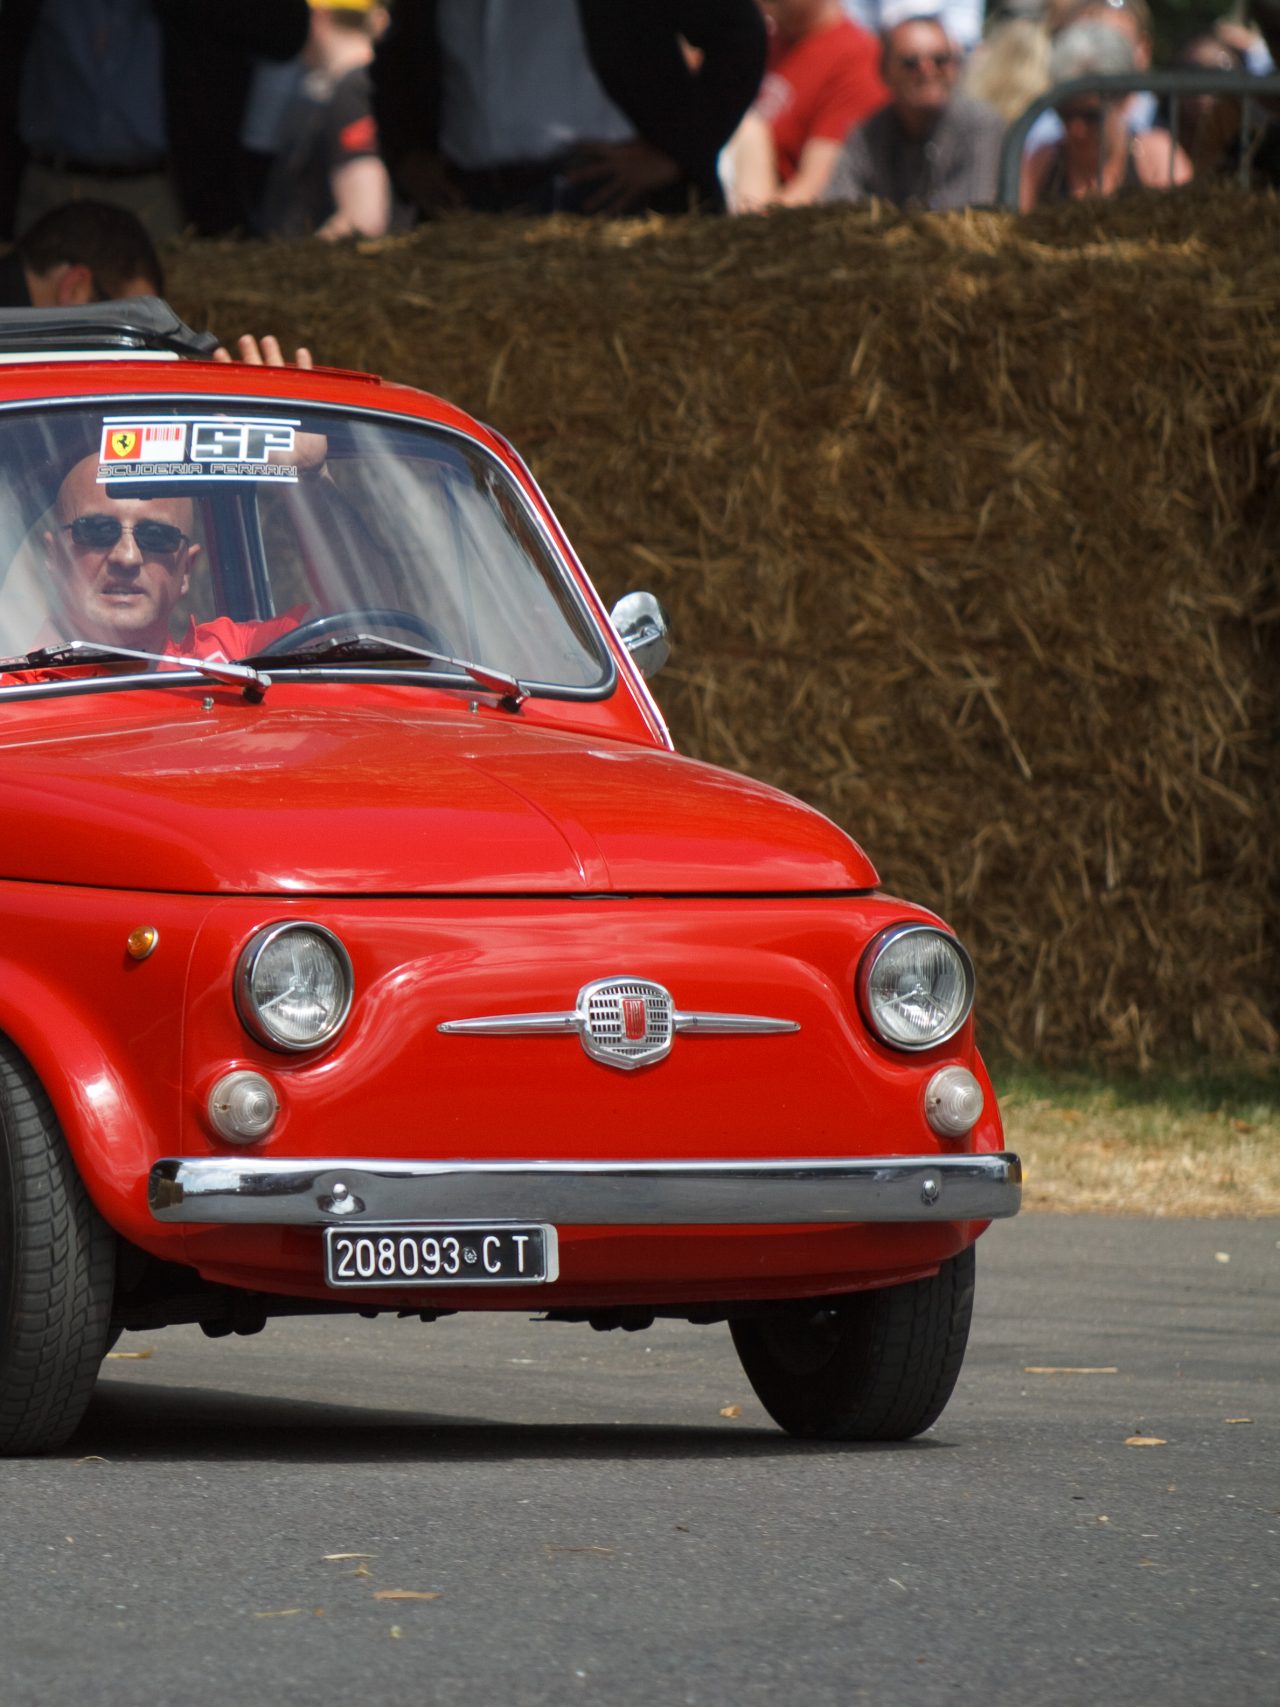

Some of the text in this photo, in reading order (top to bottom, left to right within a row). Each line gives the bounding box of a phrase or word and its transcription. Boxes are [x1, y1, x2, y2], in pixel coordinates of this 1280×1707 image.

[190, 423, 295, 463] SF
[96, 463, 298, 478] SCUDERIA FERRARI
[335, 1236, 461, 1278] 208093
